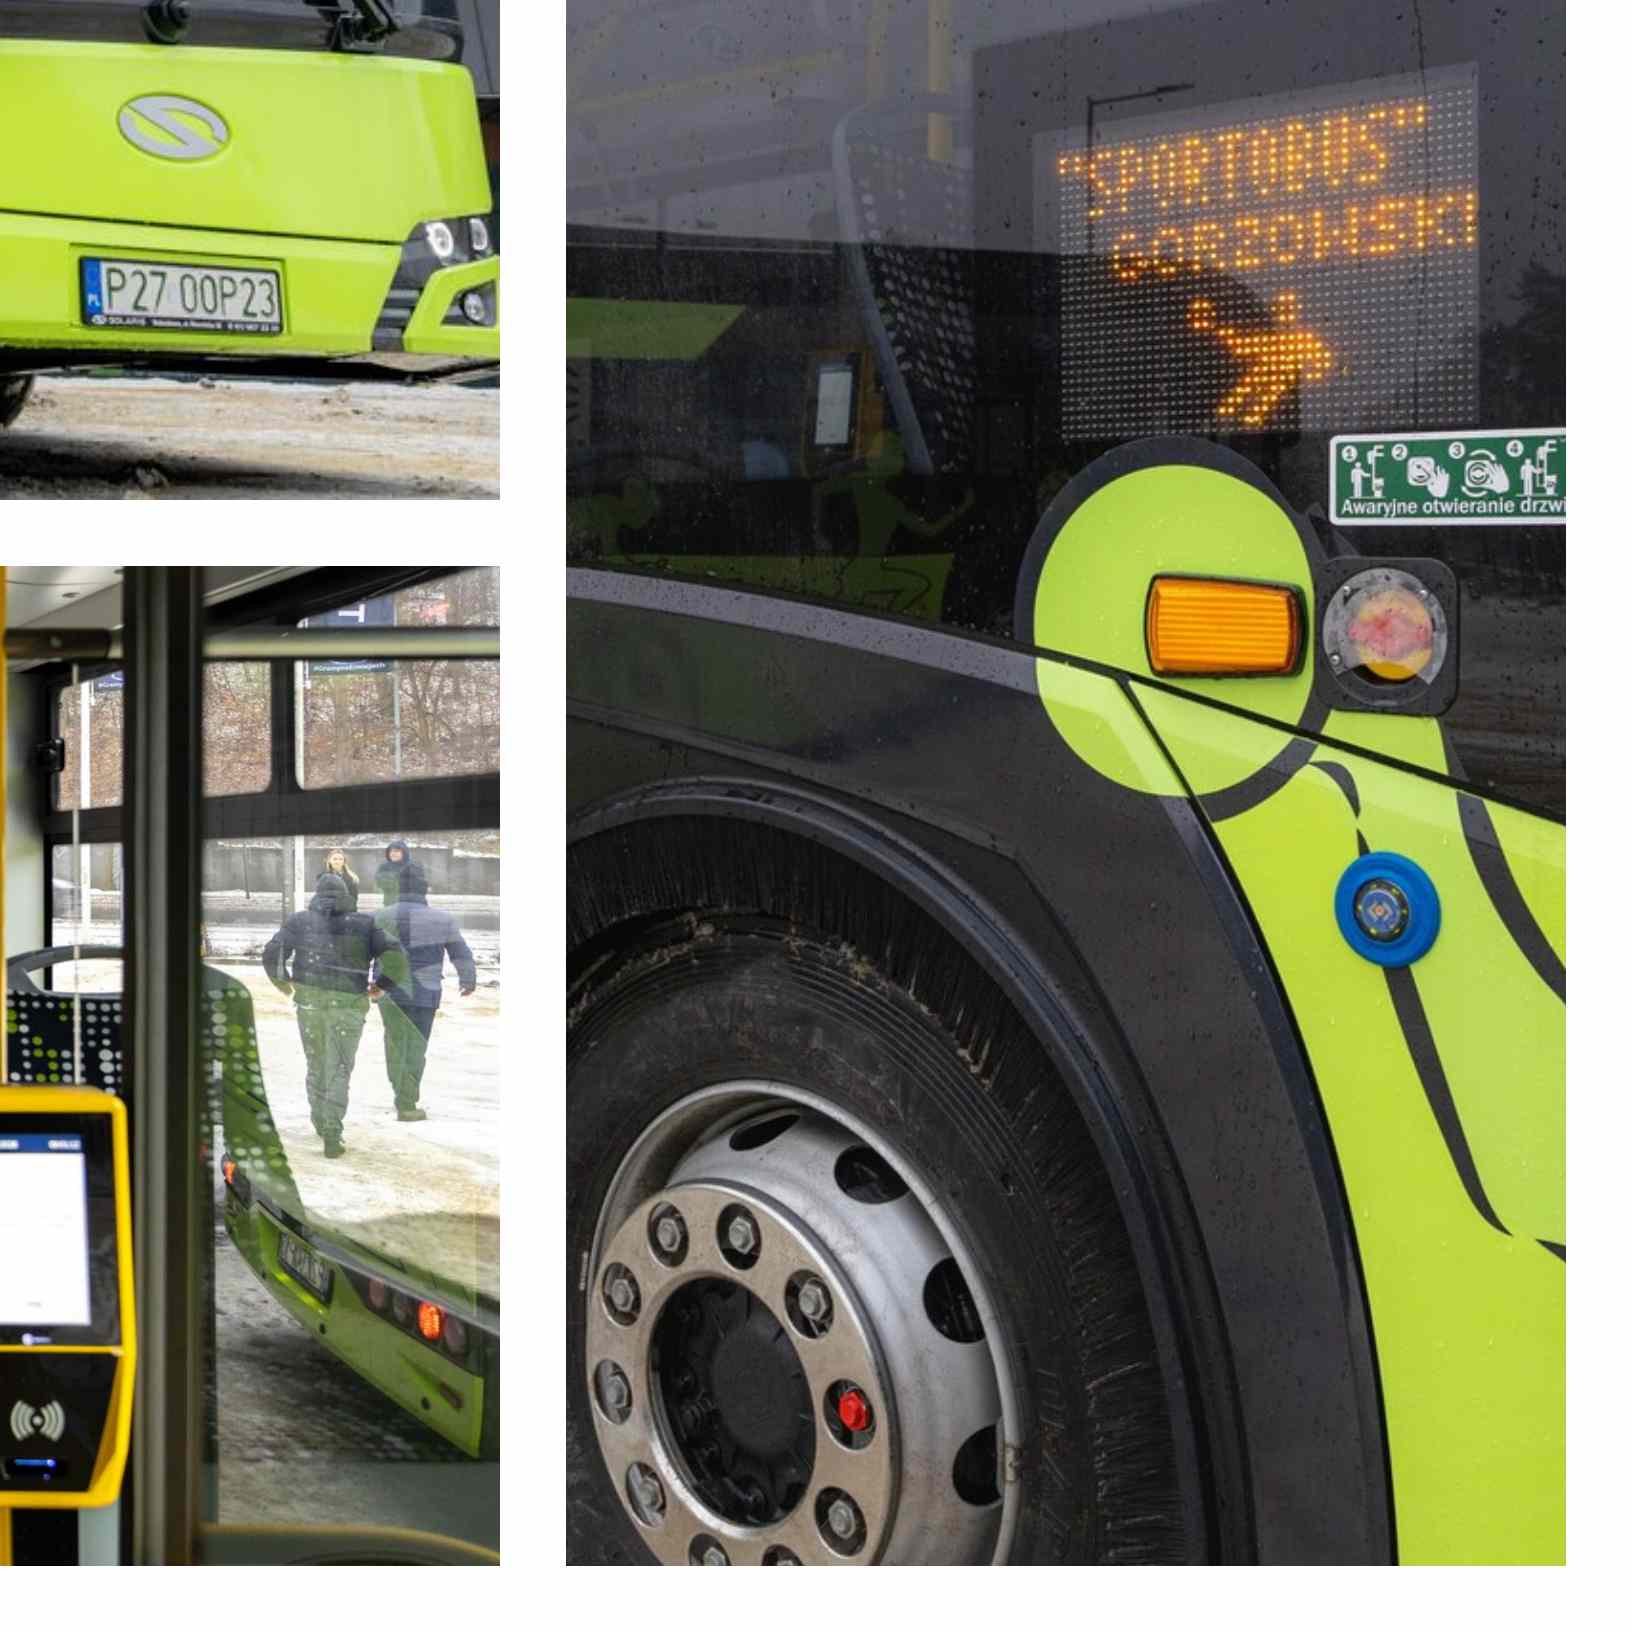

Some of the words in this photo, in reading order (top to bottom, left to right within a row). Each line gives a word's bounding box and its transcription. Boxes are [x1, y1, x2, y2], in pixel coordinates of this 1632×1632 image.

[1112, 192, 1476, 281] GORZOWSKI
[106, 267, 168, 313] P27
[1341, 498, 1417, 518] Awaryjne
[1422, 496, 1515, 514] otwieranie
